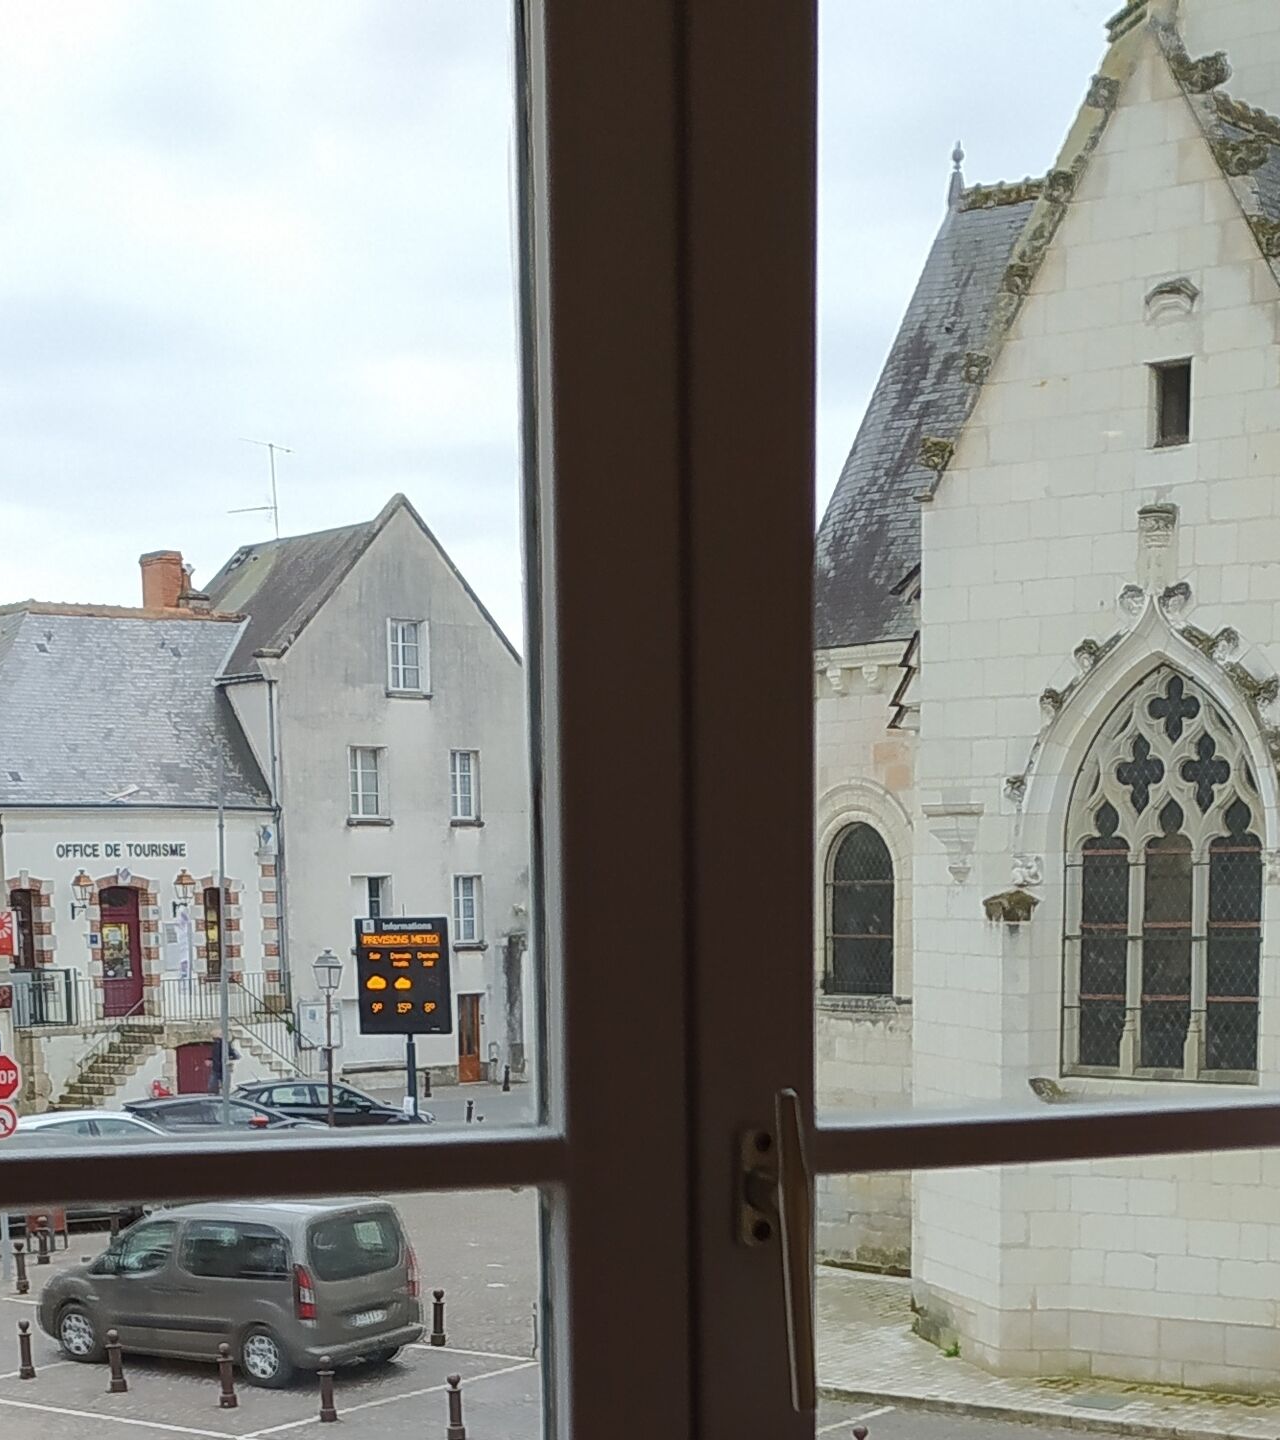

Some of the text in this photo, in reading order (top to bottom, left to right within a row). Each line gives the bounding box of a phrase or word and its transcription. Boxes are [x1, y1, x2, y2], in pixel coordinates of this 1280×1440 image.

[56, 843, 186, 858] OFFICE DE TOURISME
[382, 921, 433, 931] Informations
